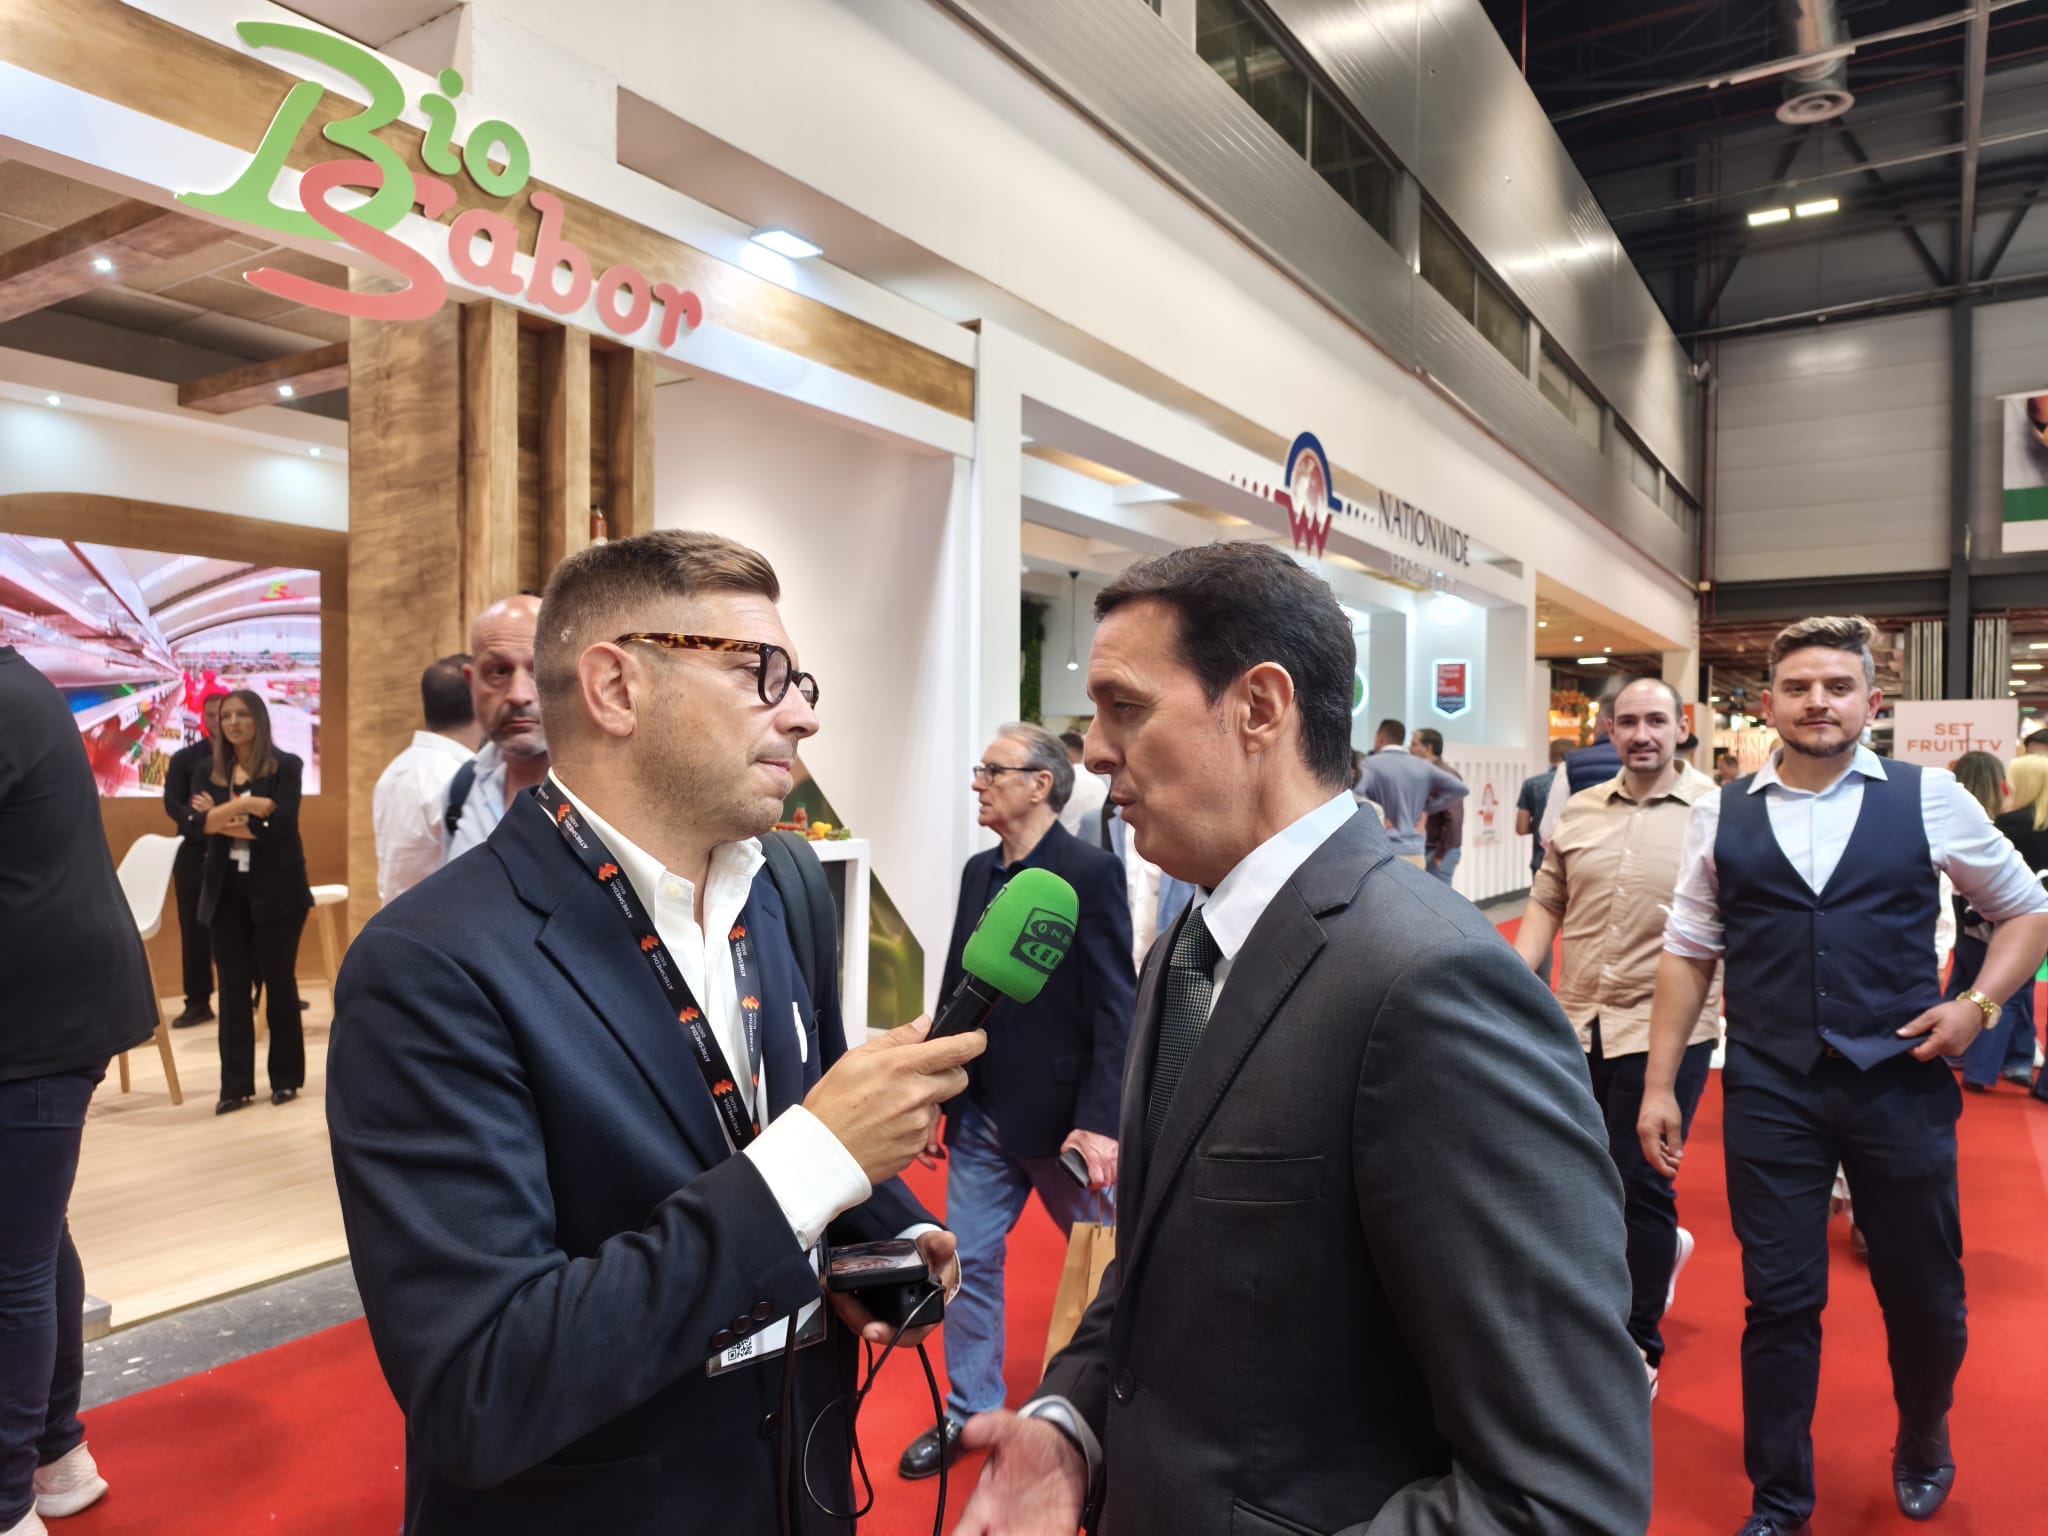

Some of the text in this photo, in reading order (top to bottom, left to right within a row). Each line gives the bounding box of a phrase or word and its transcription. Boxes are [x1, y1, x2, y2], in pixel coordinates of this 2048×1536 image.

[175, 21, 530, 241] Bio
[243, 159, 702, 348] Sabor
[1378, 490, 1470, 567] NATIONWIDE
[610, 881, 633, 919] ATRESMEDIA
[651, 952, 674, 990] ATRESMEDIA
[690, 1024, 711, 1062] ATRESMEDIA
[723, 1098, 742, 1136] ATRESMEDIA
